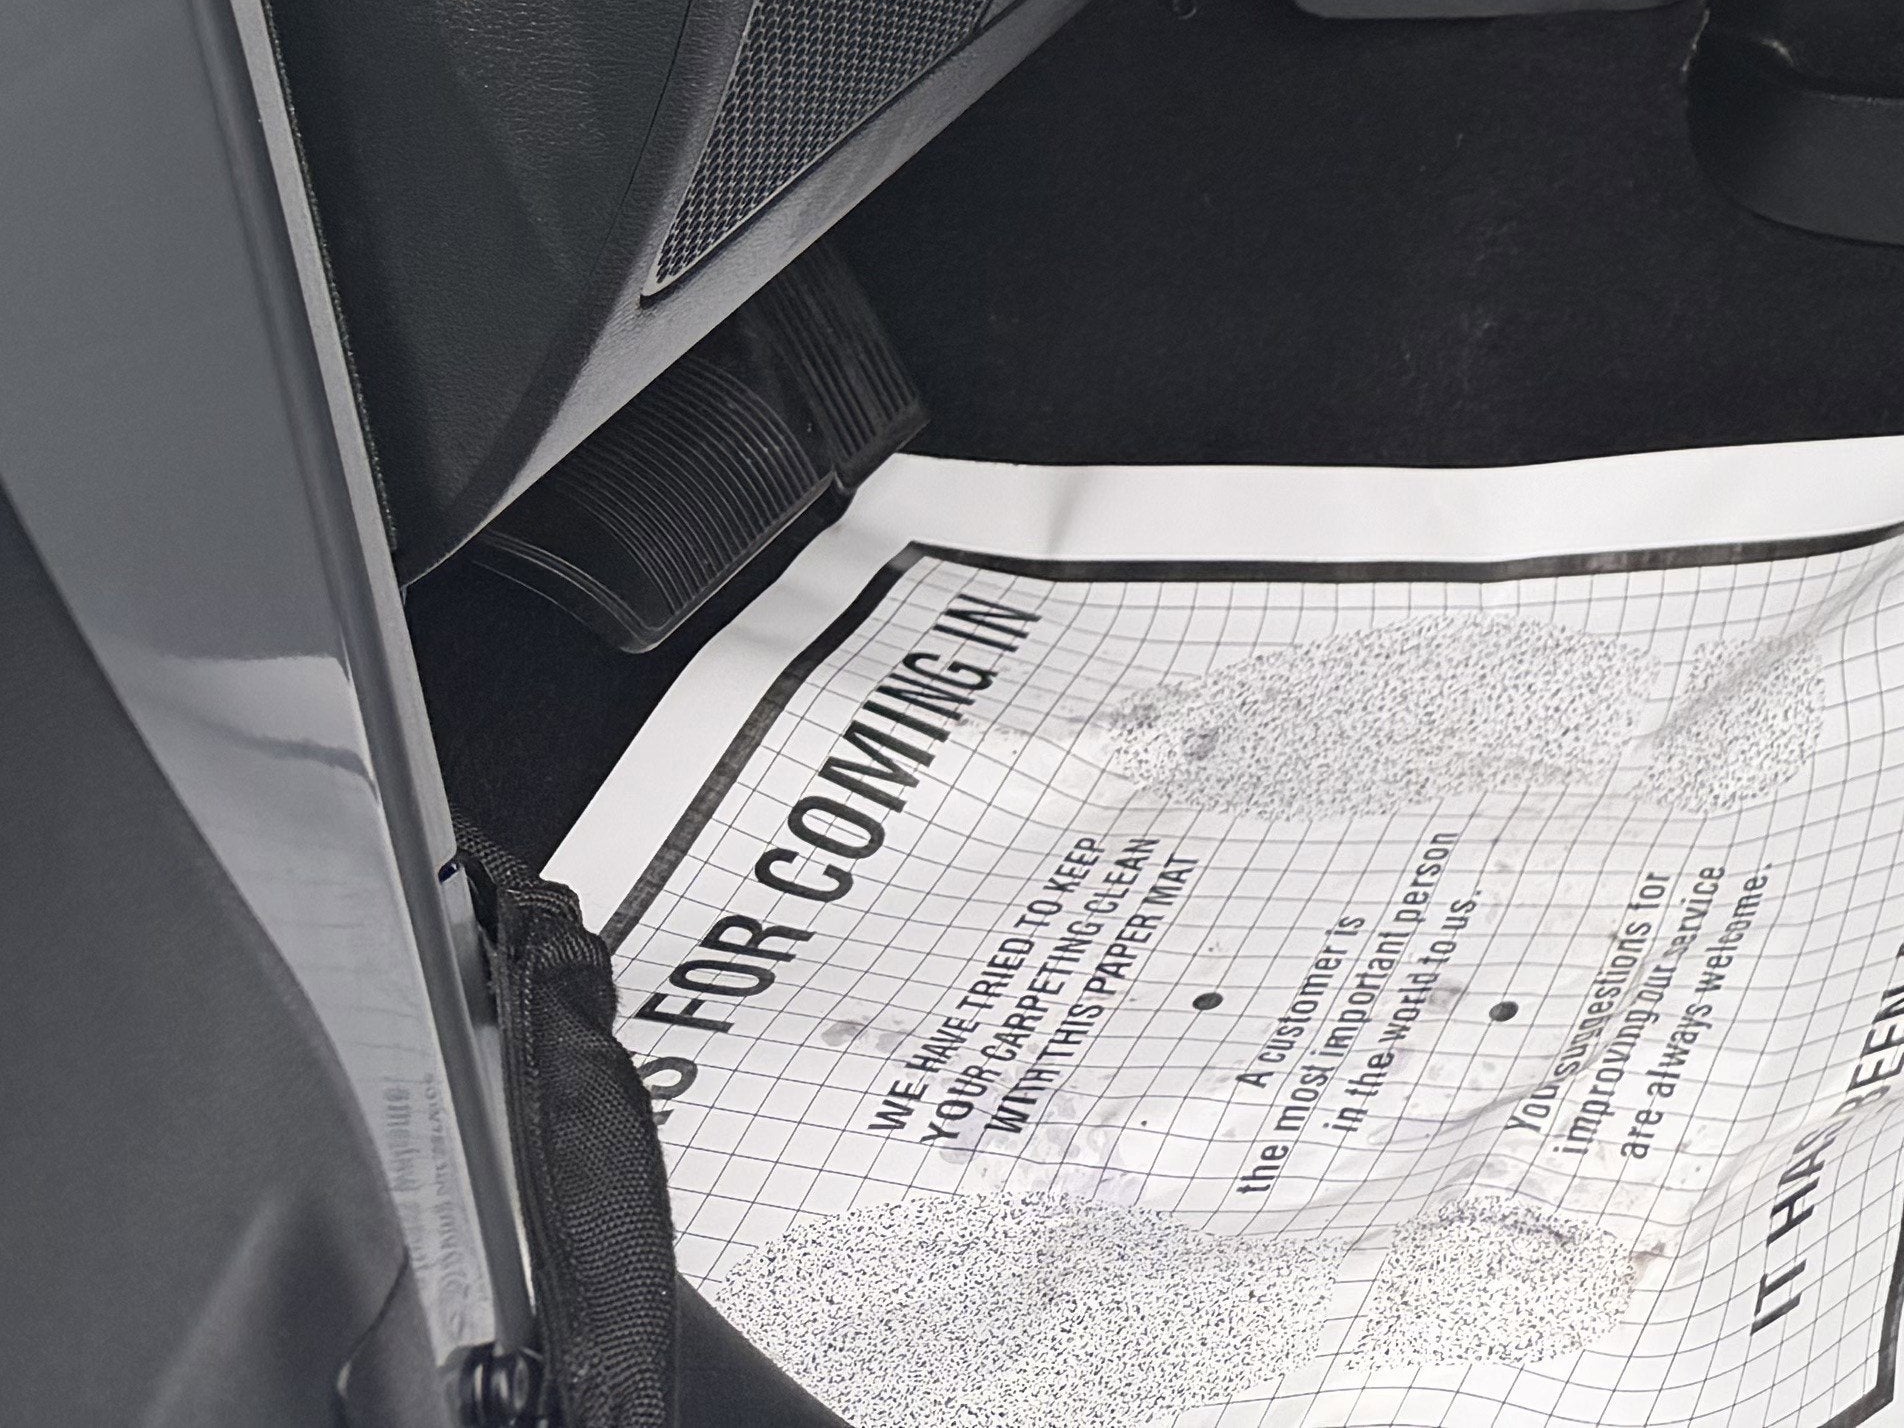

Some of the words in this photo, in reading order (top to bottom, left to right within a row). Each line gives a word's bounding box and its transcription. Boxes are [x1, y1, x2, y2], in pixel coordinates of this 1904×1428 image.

[635, 914, 816, 1034] FOR
[754, 651, 997, 902] COMING
[934, 593, 1042, 653] IN
[868, 1080, 929, 1131] WE
[904, 1017, 980, 1073] HAVE
[955, 938, 1035, 1010] TRIED
[1013, 899, 1063, 930] TO
[1044, 837, 1105, 893] KEEP
[920, 1065, 1001, 1143] YOUR
[980, 920, 1105, 1062] CARPETING
[1084, 837, 1161, 914] CLEAN
[984, 1069, 1061, 1134] WITH
[1037, 1004, 1104, 1060] THIS
[1083, 915, 1163, 995] PAPER
[1145, 852, 1200, 907] MAT
[1235, 1071, 1274, 1089] A
[1259, 948, 1349, 1065] customer
[1325, 914, 1365, 937] is
[1237, 1145, 1289, 1196] the
[1274, 1056, 1336, 1132] most
[1310, 930, 1410, 1058] important
[1393, 831, 1460, 925] person
[1323, 1107, 1368, 1133] in
[1346, 1052, 1396, 1097] the
[1379, 971, 1438, 1042] world
[1418, 938, 1456, 965] to
[1442, 889, 1483, 931] us.
[1553, 1008, 1659, 1155] improving
[1636, 964, 1678, 1004] our
[1663, 866, 1725, 956] service
[1554, 921, 1652, 1078] suggestions
[1627, 872, 1671, 910] for
[1620, 1109, 1663, 1160] are
[1646, 1002, 1713, 1098] always
[1694, 863, 1773, 994] welcome.
[1751, 1258, 1807, 1336] IT
[1765, 1115, 1855, 1247] HAS
